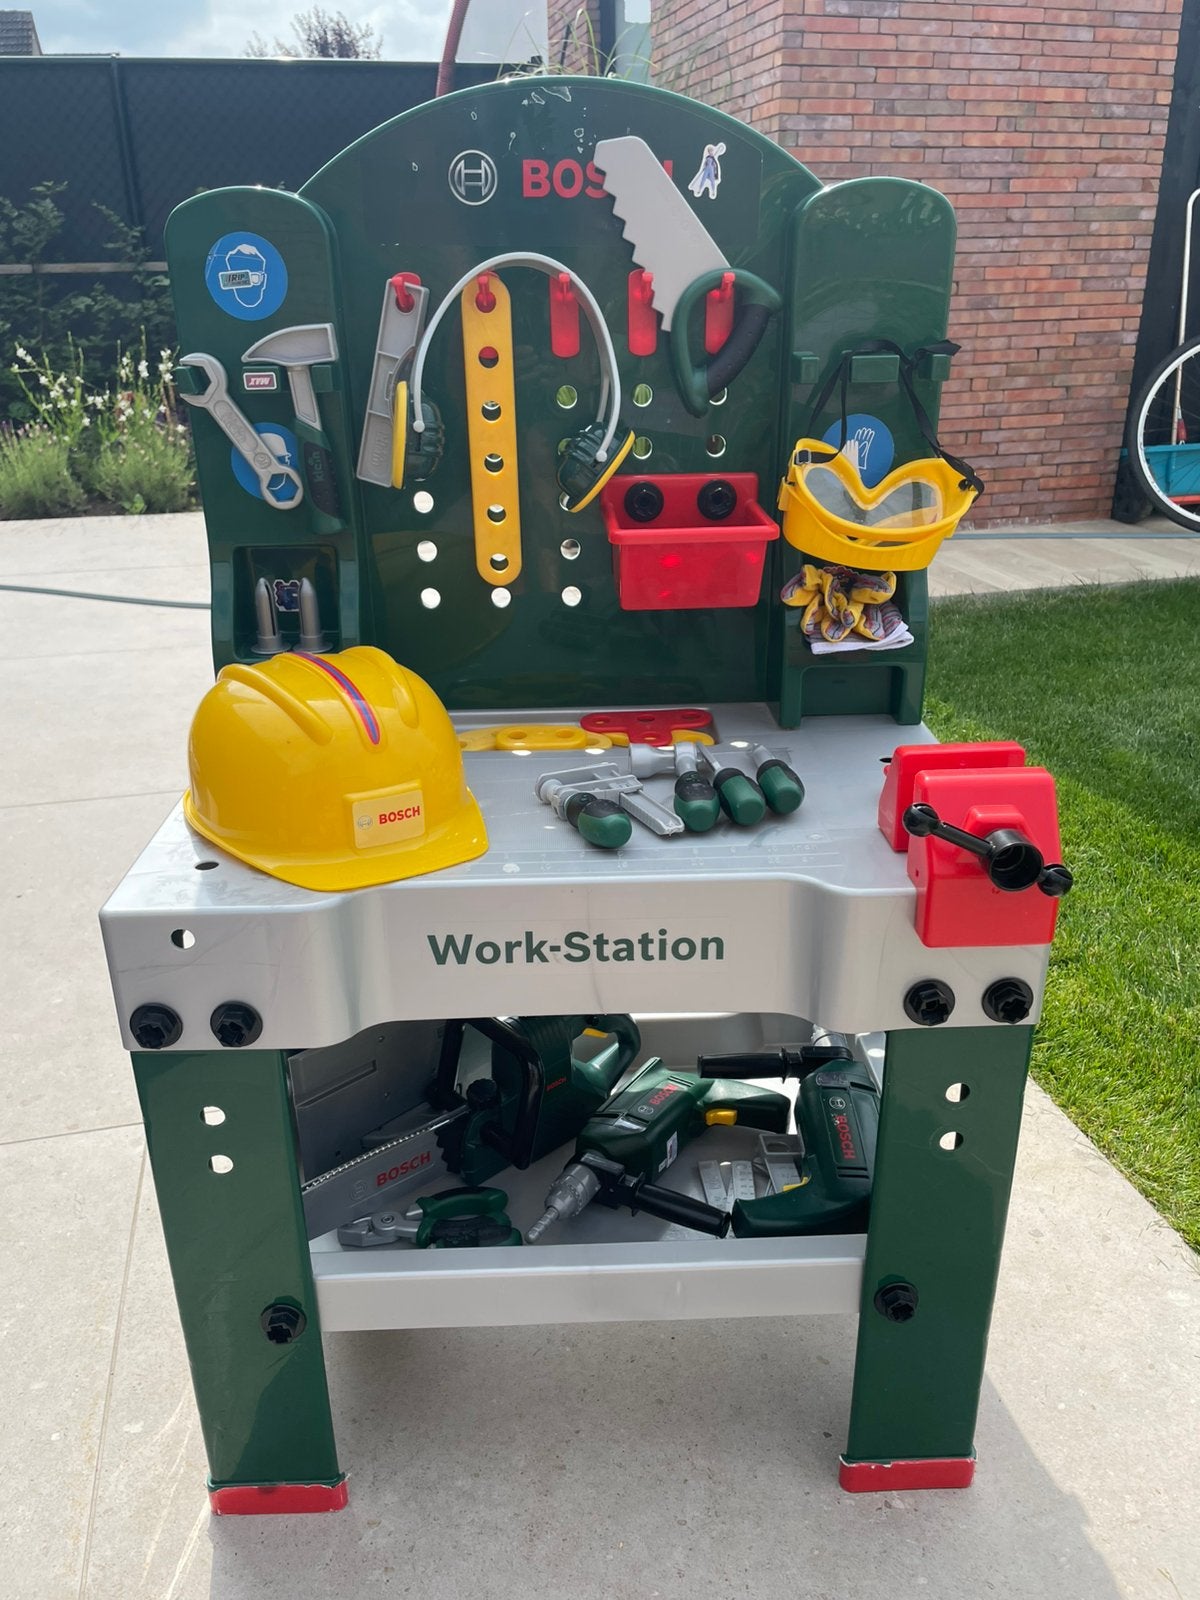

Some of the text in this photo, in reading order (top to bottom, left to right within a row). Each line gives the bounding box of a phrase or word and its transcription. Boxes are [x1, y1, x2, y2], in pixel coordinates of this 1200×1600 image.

[522, 159, 673, 198] BOS
[379, 806, 421, 825] BOSCH
[427, 928, 725, 965] Work-Station
[649, 1083, 679, 1105] BOSCH
[835, 1115, 856, 1159] BOSCH
[376, 1151, 431, 1187] BOSCH
